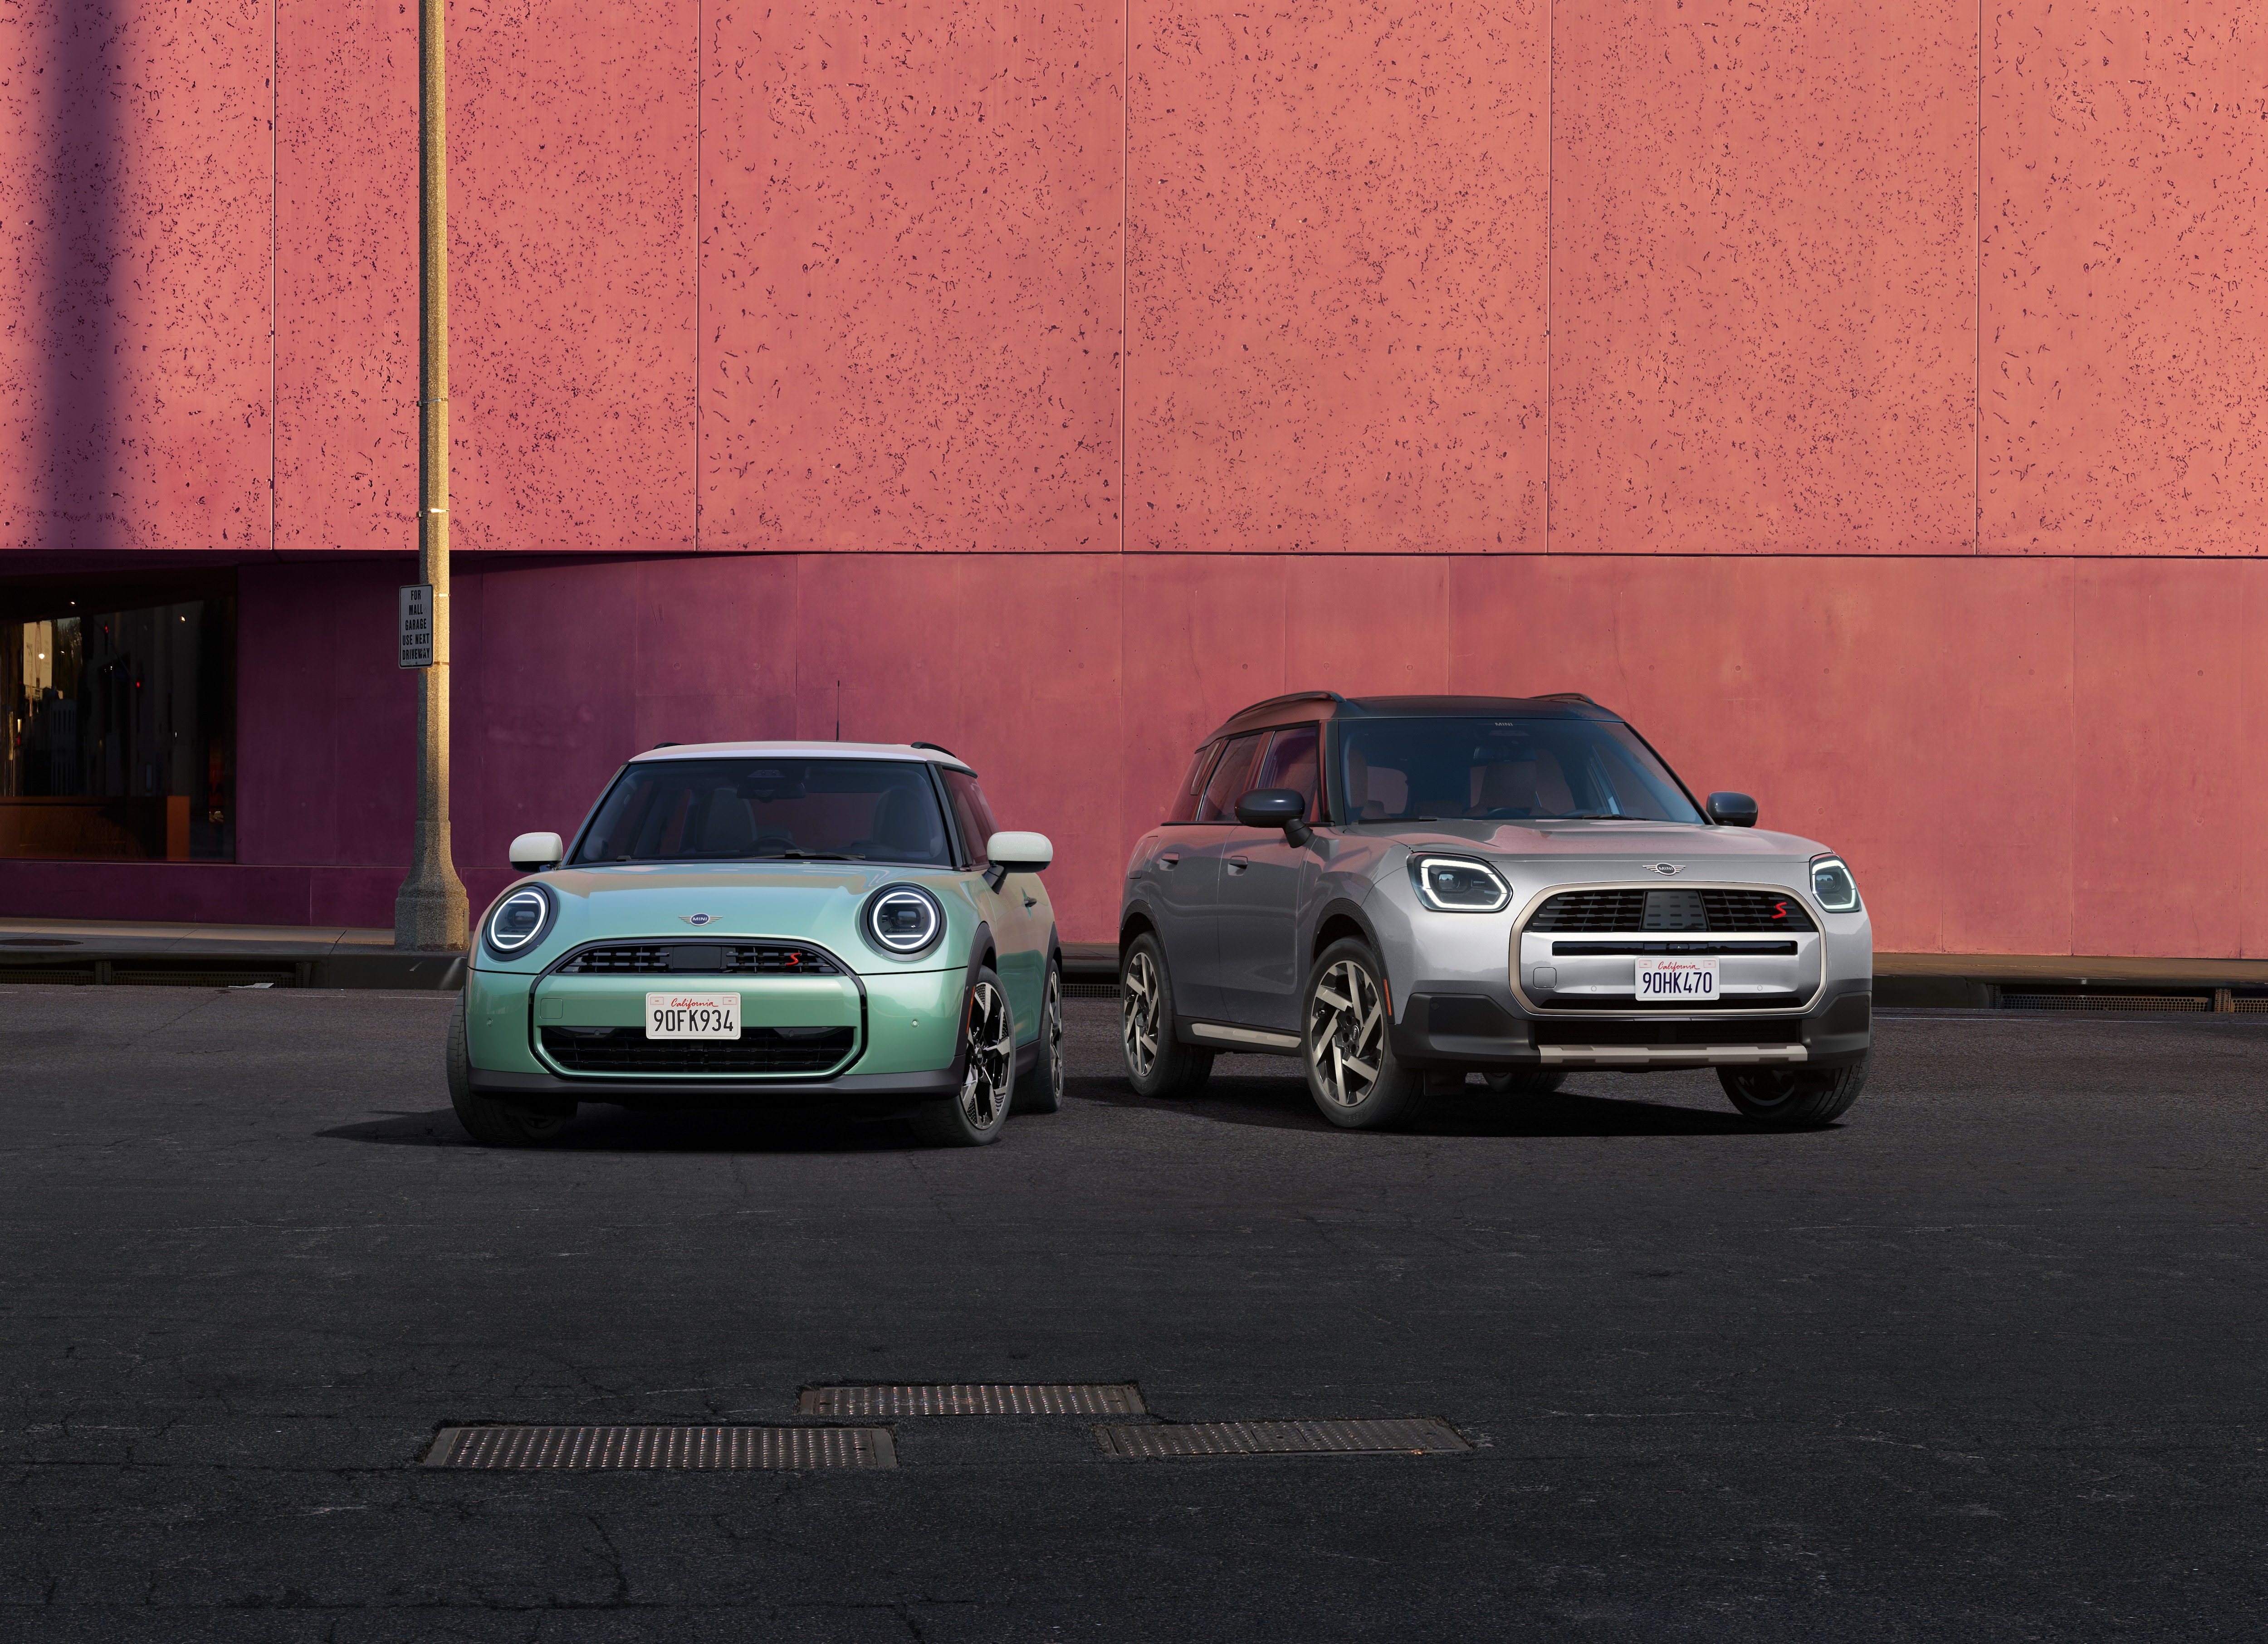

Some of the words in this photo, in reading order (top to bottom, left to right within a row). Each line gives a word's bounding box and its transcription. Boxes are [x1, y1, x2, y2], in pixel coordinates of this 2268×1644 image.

[411, 590, 421, 600] FOR
[409, 604, 423, 615] MALL
[405, 618, 426, 630] GARAGE
[402, 634, 412, 646] USE
[415, 633, 430, 645] NEXT
[402, 648, 430, 660] DRIVEWAY
[1771, 902, 1787, 919] S
[786, 952, 801, 966] S
[1658, 961, 1700, 972] California
[671, 998, 719, 1010] California
